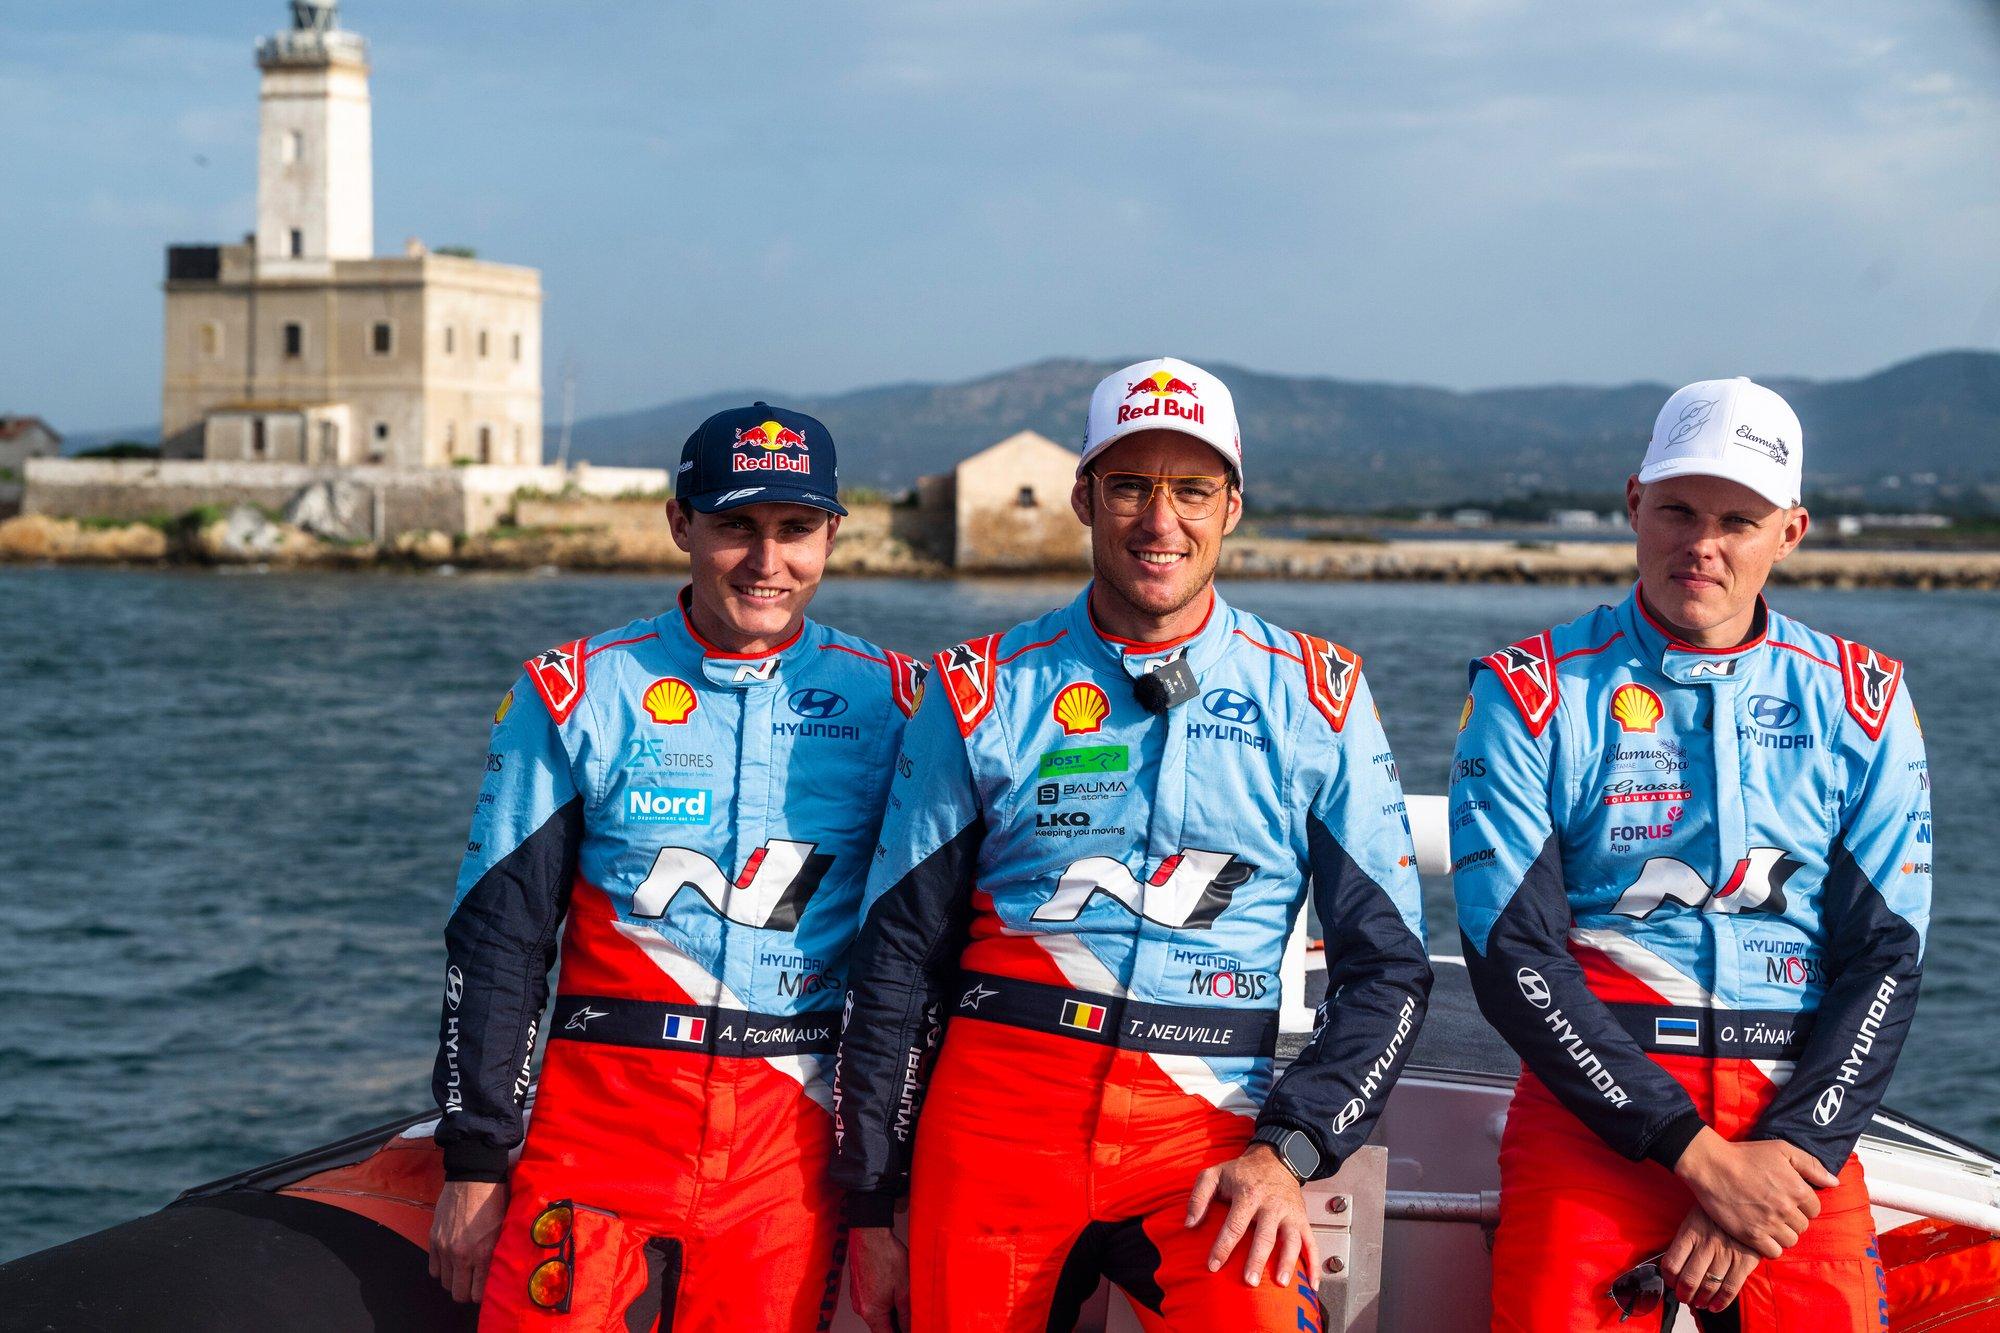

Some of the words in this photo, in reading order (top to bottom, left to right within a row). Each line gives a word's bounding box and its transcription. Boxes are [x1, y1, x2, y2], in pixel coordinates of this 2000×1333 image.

[1117, 398, 1160, 425] Red
[1164, 399, 1205, 425] Bull
[1736, 424, 1779, 452] Elamus
[733, 451, 773, 472] Red
[774, 452, 811, 475] Bull
[772, 722, 860, 741] HYUNDAI
[1187, 723, 1271, 753] HYUNDAI
[1736, 725, 1814, 749] HYUNDAI
[664, 753, 714, 768] STORES
[1045, 754, 1082, 768] JOST
[1606, 743, 1662, 764] Elamus
[1655, 752, 1690, 775] Spa
[1063, 780, 1128, 795] BAUMA
[1080, 793, 1110, 801] stone
[1603, 779, 1691, 796] Grossi
[1604, 792, 1691, 804] TOIDUKAUBAD
[630, 791, 706, 816] Nord
[1036, 811, 1091, 828] LKQ
[1035, 828, 1072, 839] Keeping
[1073, 828, 1090, 838] you
[1091, 826, 1126, 836] moving
[1610, 824, 1673, 841] FORUS
[1610, 843, 1631, 854] App
[1742, 939, 1804, 955] HYUNDAI
[760, 953, 825, 971] HYUNDAI
[1173, 949, 1241, 973] HYUNDAI
[1187, 969, 1267, 1001] MOBIS
[718, 1025, 738, 1042] A.
[743, 1027, 830, 1044] FOURMAUX
[1128, 1019, 1144, 1038] T.
[1147, 1023, 1233, 1045] NEUVILLE
[1720, 1025, 1739, 1043] O.
[1743, 1022, 1796, 1045] TÄNAK
[1836, 975, 1898, 1085] HYUNDAI
[1360, 995, 1416, 1099] HYUNDAI
[1544, 1008, 1633, 1109] HYUNDAI
